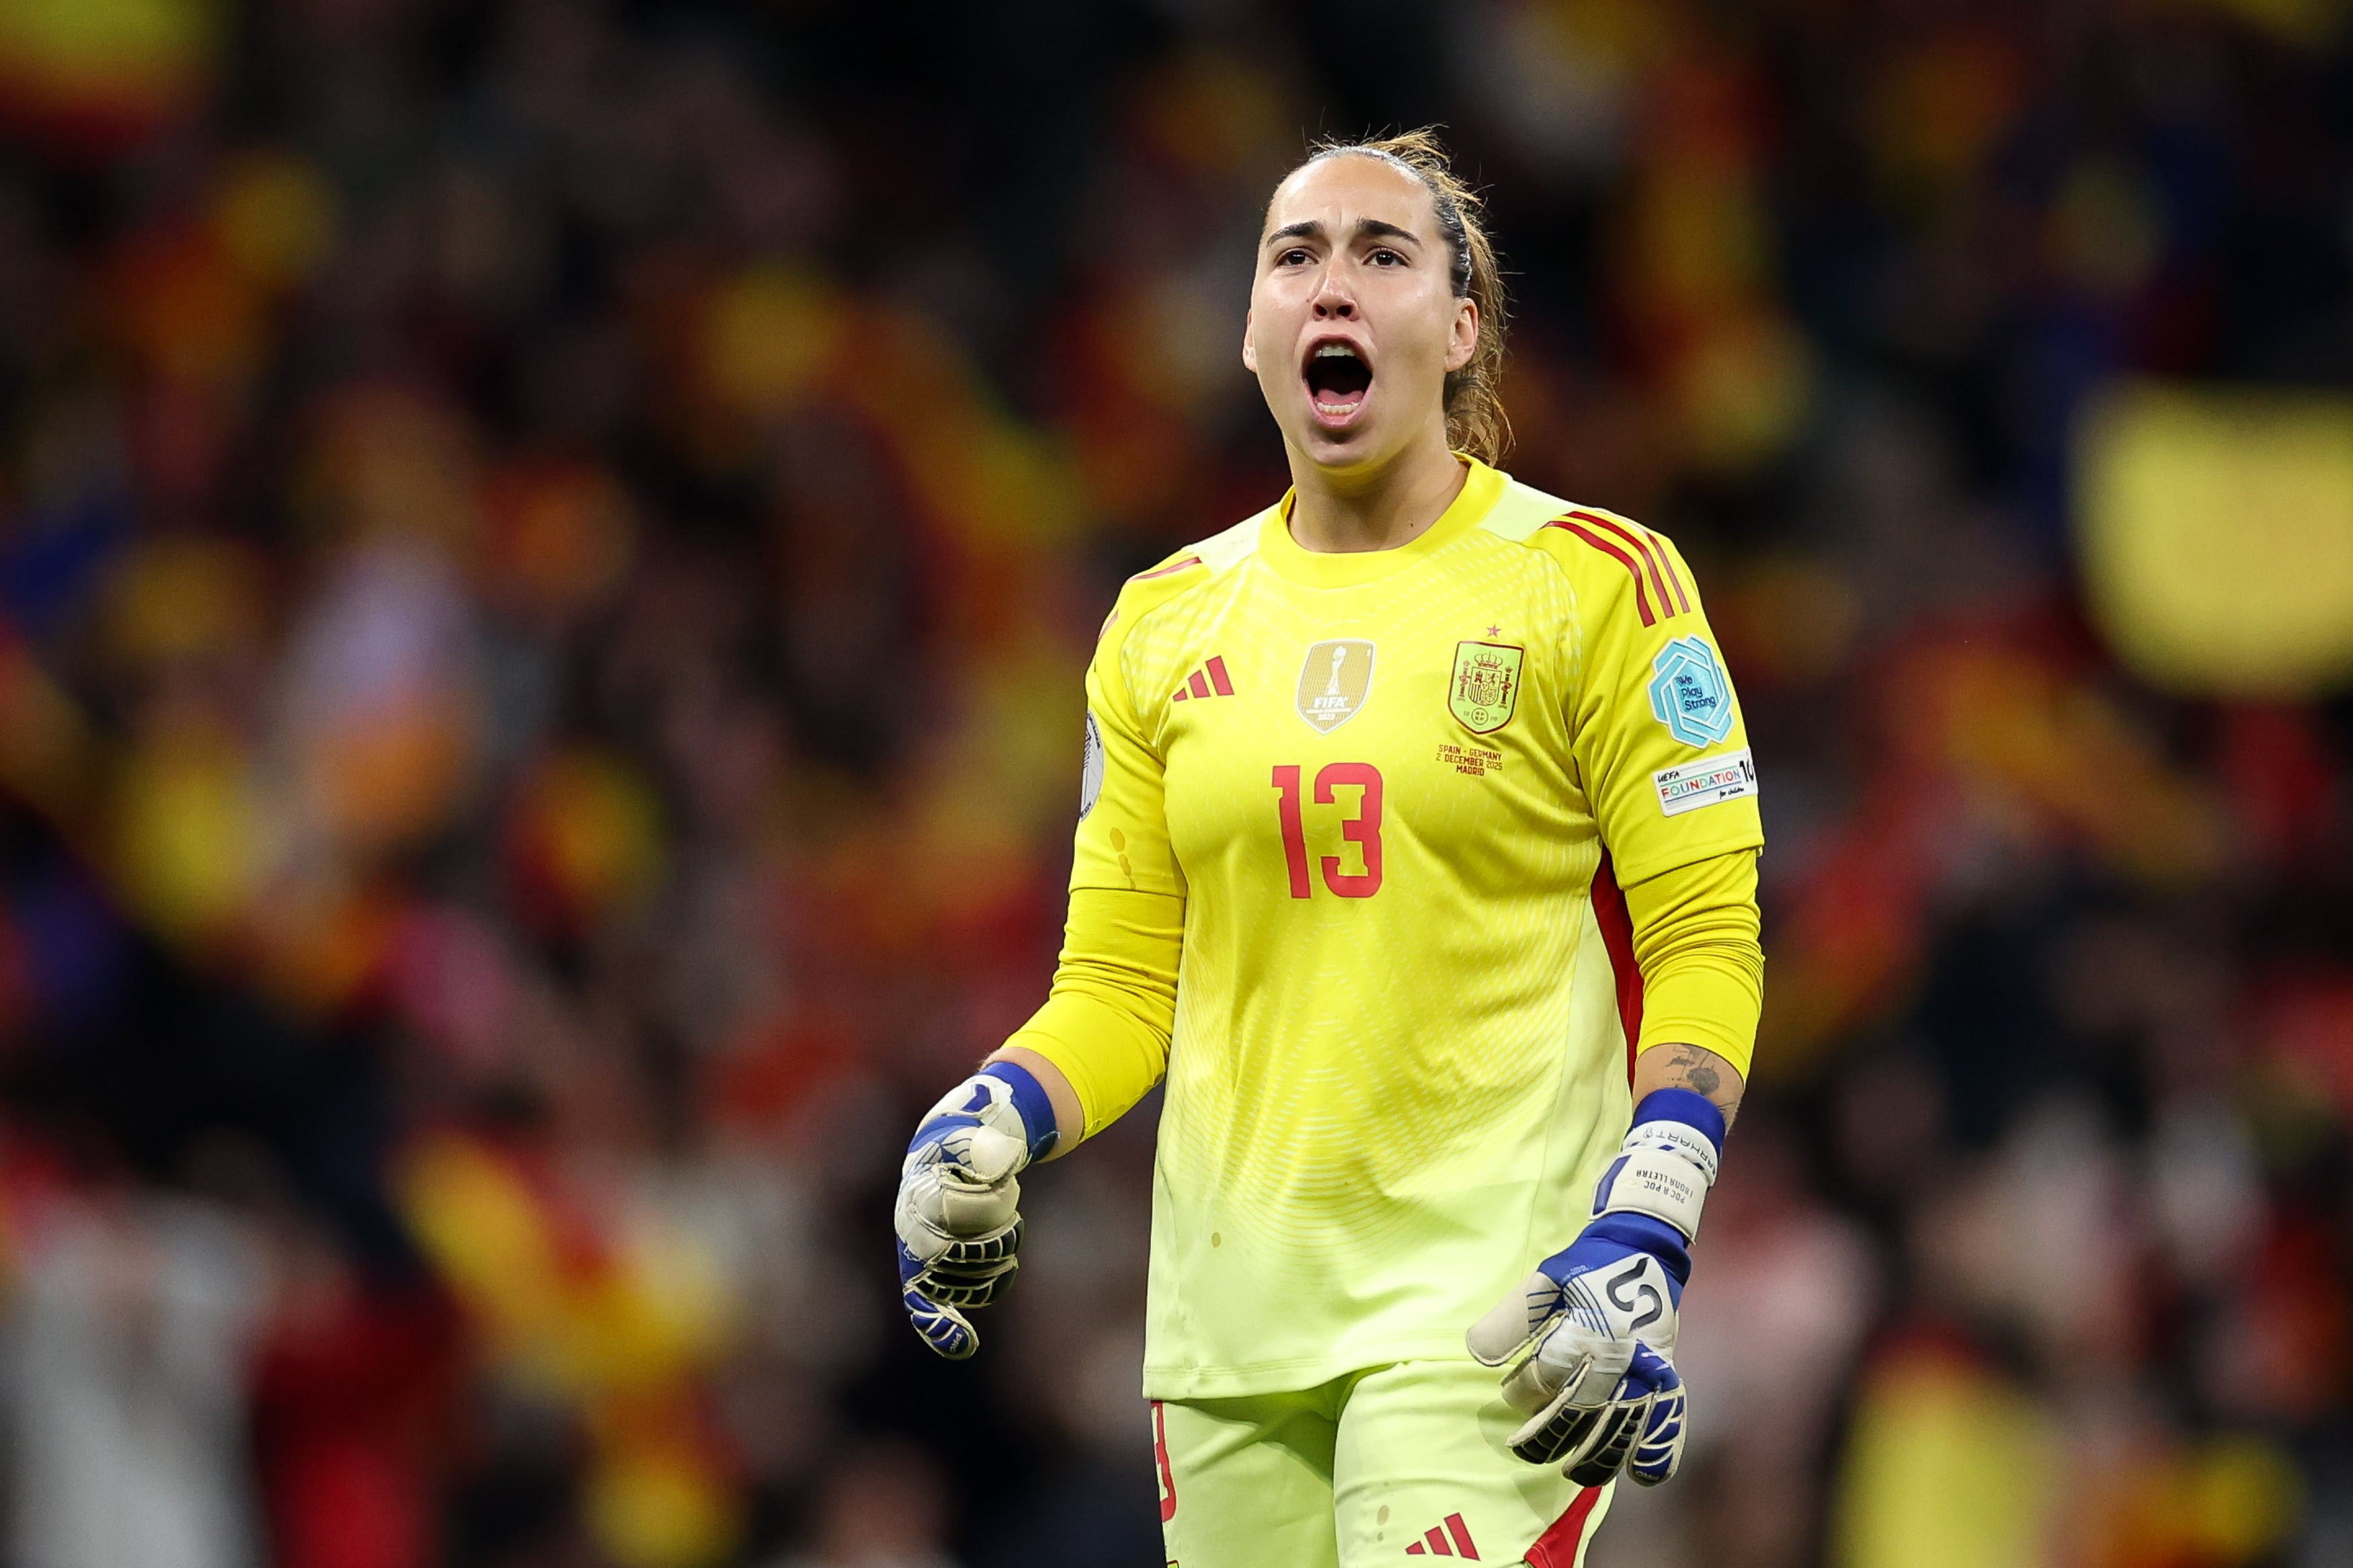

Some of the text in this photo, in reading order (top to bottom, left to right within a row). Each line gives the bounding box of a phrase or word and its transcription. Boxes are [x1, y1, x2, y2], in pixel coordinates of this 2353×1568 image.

[1675, 675, 1693, 685] We
[1681, 686, 1703, 699] Play
[1314, 696, 1345, 708] FIFA
[1685, 696, 1716, 710] Strong
[1438, 744, 1462, 755] SPAIN
[1469, 748, 1502, 761] GERMANY
[1436, 753, 1503, 771] 2 DECEMBER 2025
[1455, 764, 1484, 776] MADRID
[1657, 770, 1680, 783] UEFA
[1661, 768, 1741, 798] FOUNDATION
[1272, 762, 1383, 899] 13
[1636, 1169, 1668, 1183] LLETRA
[1643, 1180, 1685, 1204] POC A POC
